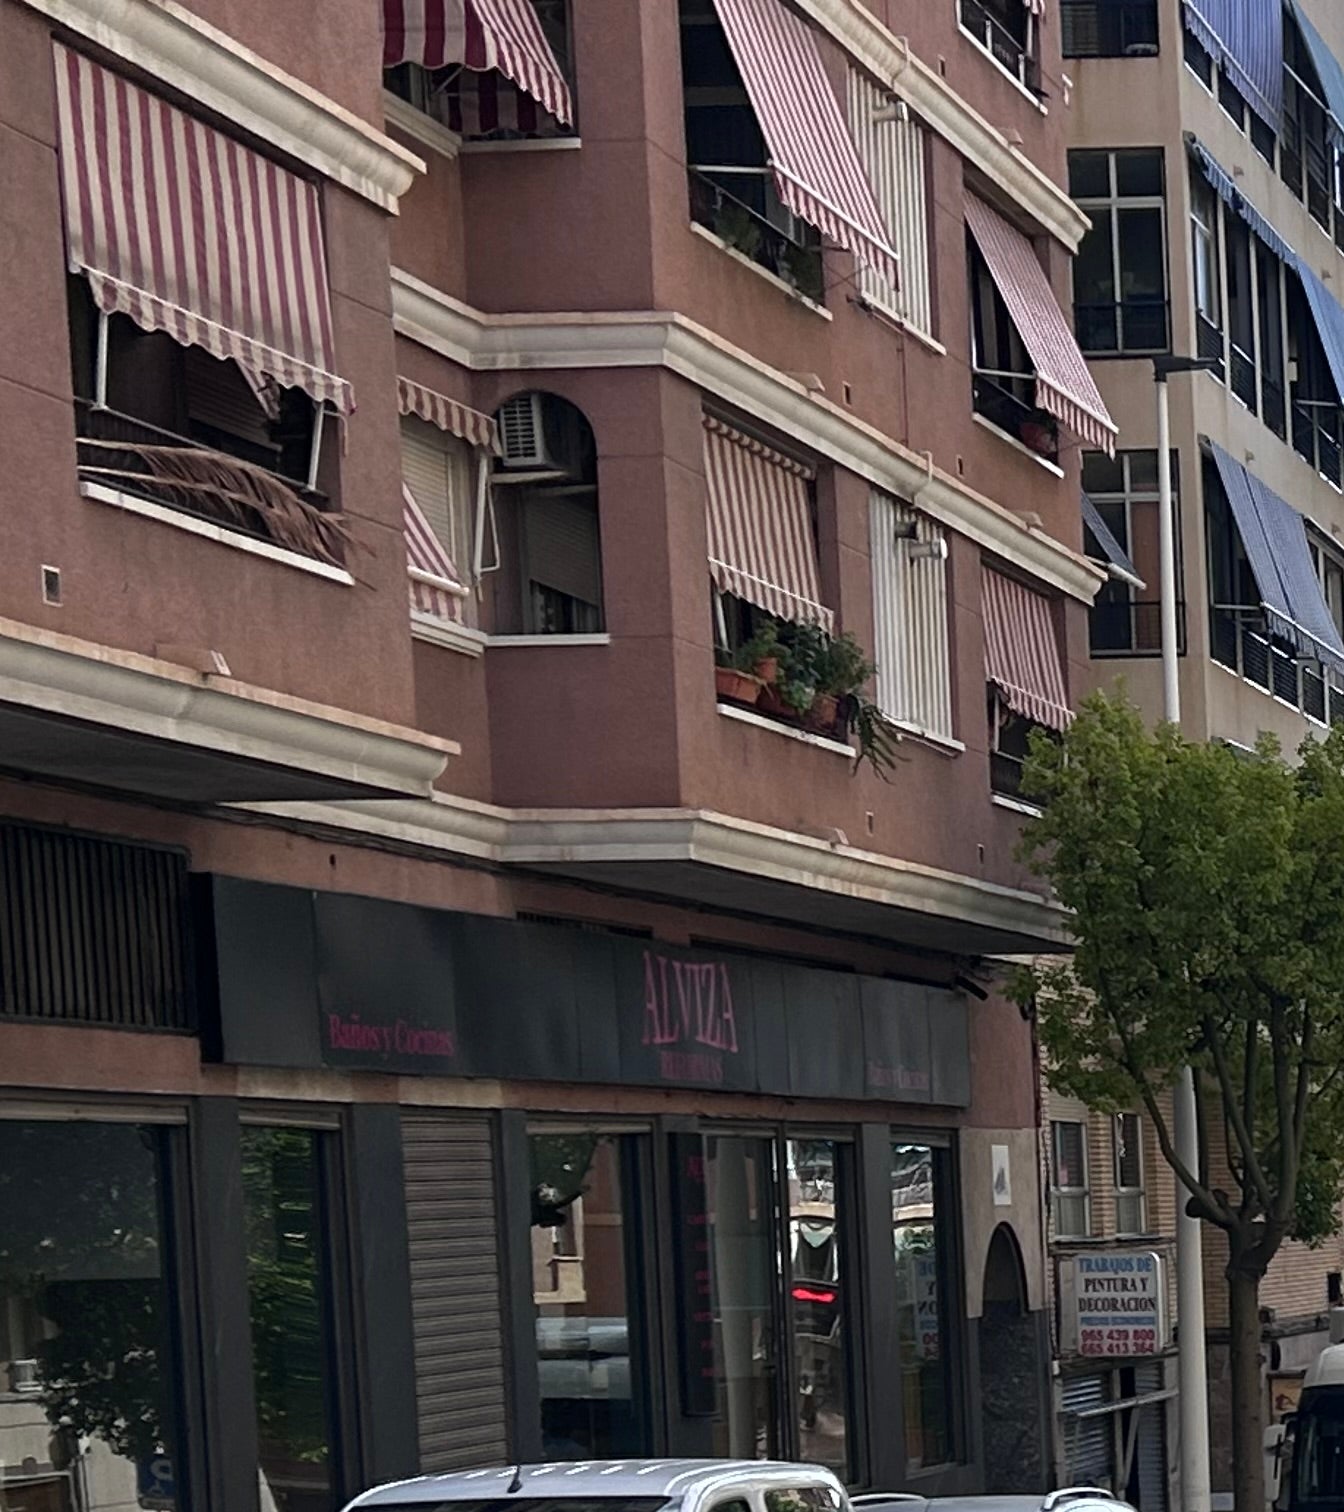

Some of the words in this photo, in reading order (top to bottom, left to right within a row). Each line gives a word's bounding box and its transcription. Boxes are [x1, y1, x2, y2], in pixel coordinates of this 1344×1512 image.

[642, 950, 738, 1052] ALVIZA
[1079, 1257, 1135, 1274] TRABAJOS
[1137, 1257, 1152, 1272] DE
[1084, 1277, 1137, 1293] PINTURA
[1139, 1277, 1148, 1292] Y
[1078, 1297, 1156, 1312] DECORACION
